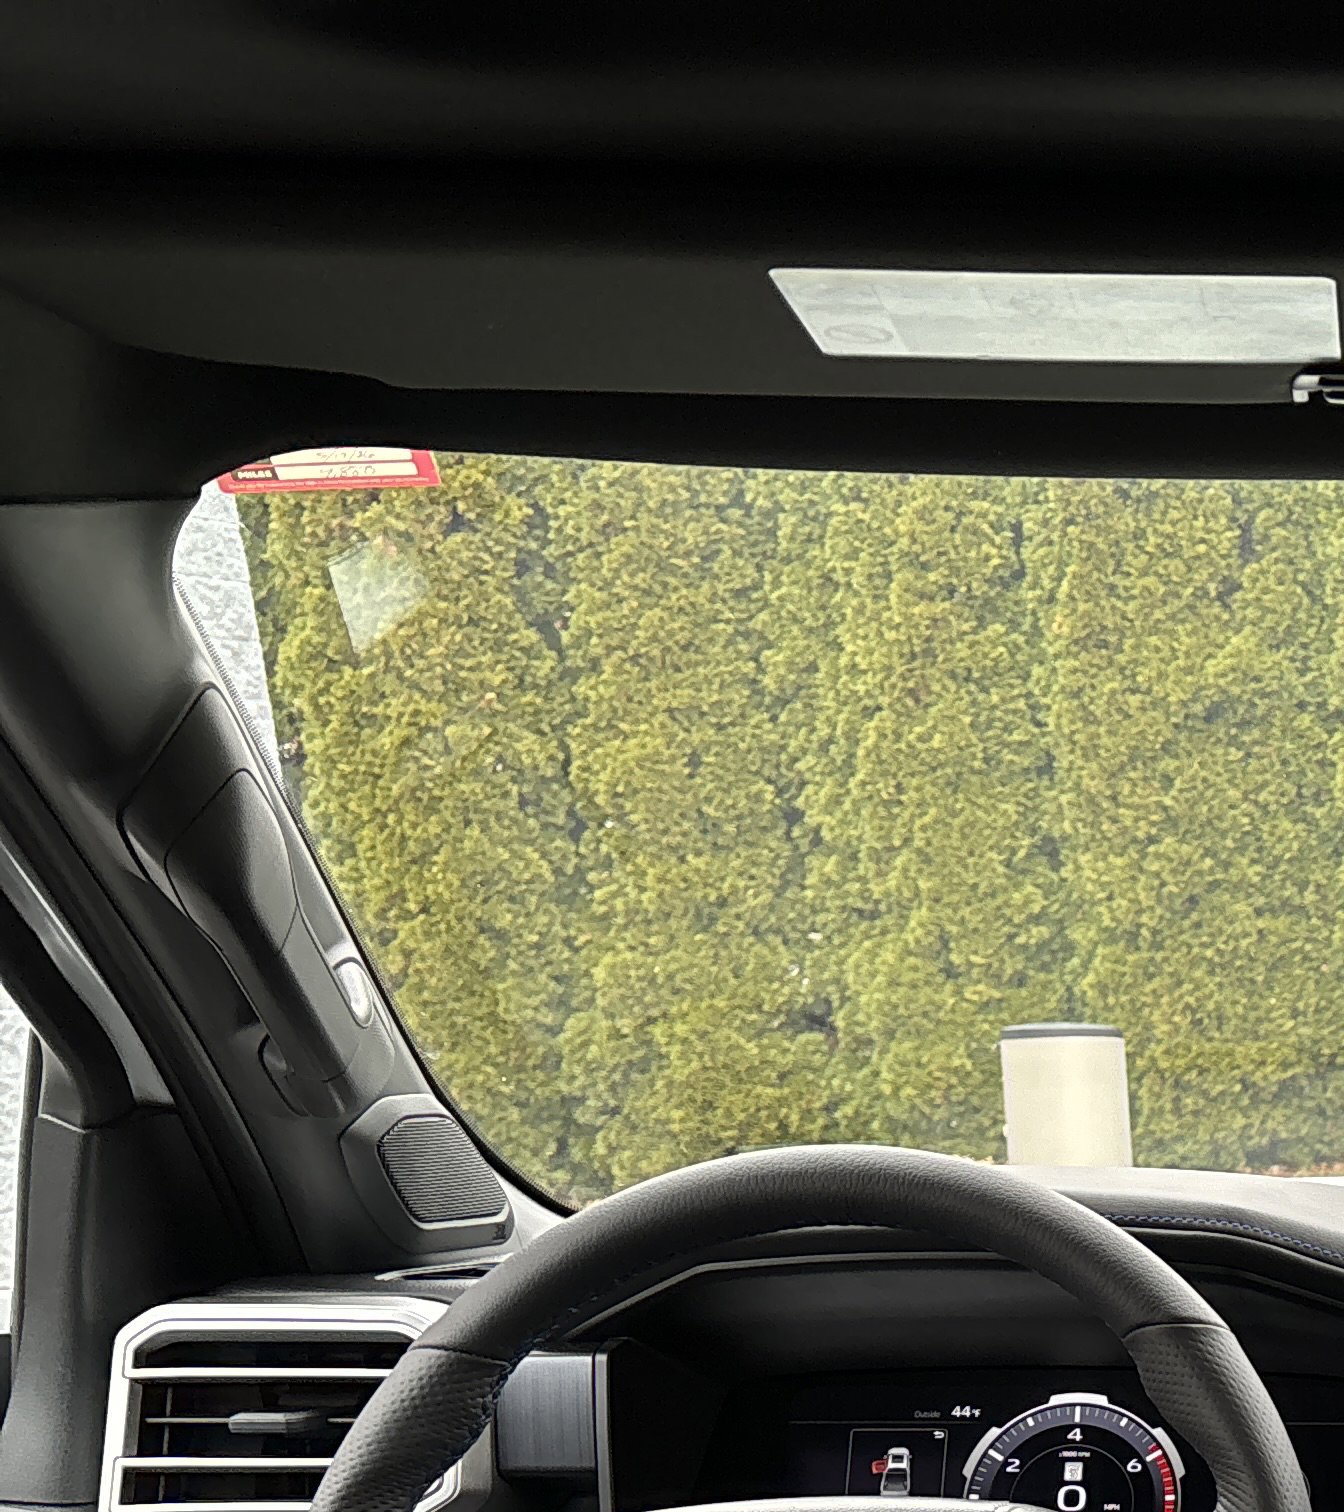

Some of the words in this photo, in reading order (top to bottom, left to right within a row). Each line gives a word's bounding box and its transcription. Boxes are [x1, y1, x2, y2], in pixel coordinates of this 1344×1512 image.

[914, 1410, 941, 1418] Outside
[1066, 1428, 1083, 1441] 4
[1005, 1458, 1021, 1473] 2
[1126, 1458, 1142, 1473] 6
[1057, 1485, 1086, 1512] 0
[1103, 1503, 1121, 1511] MPH
